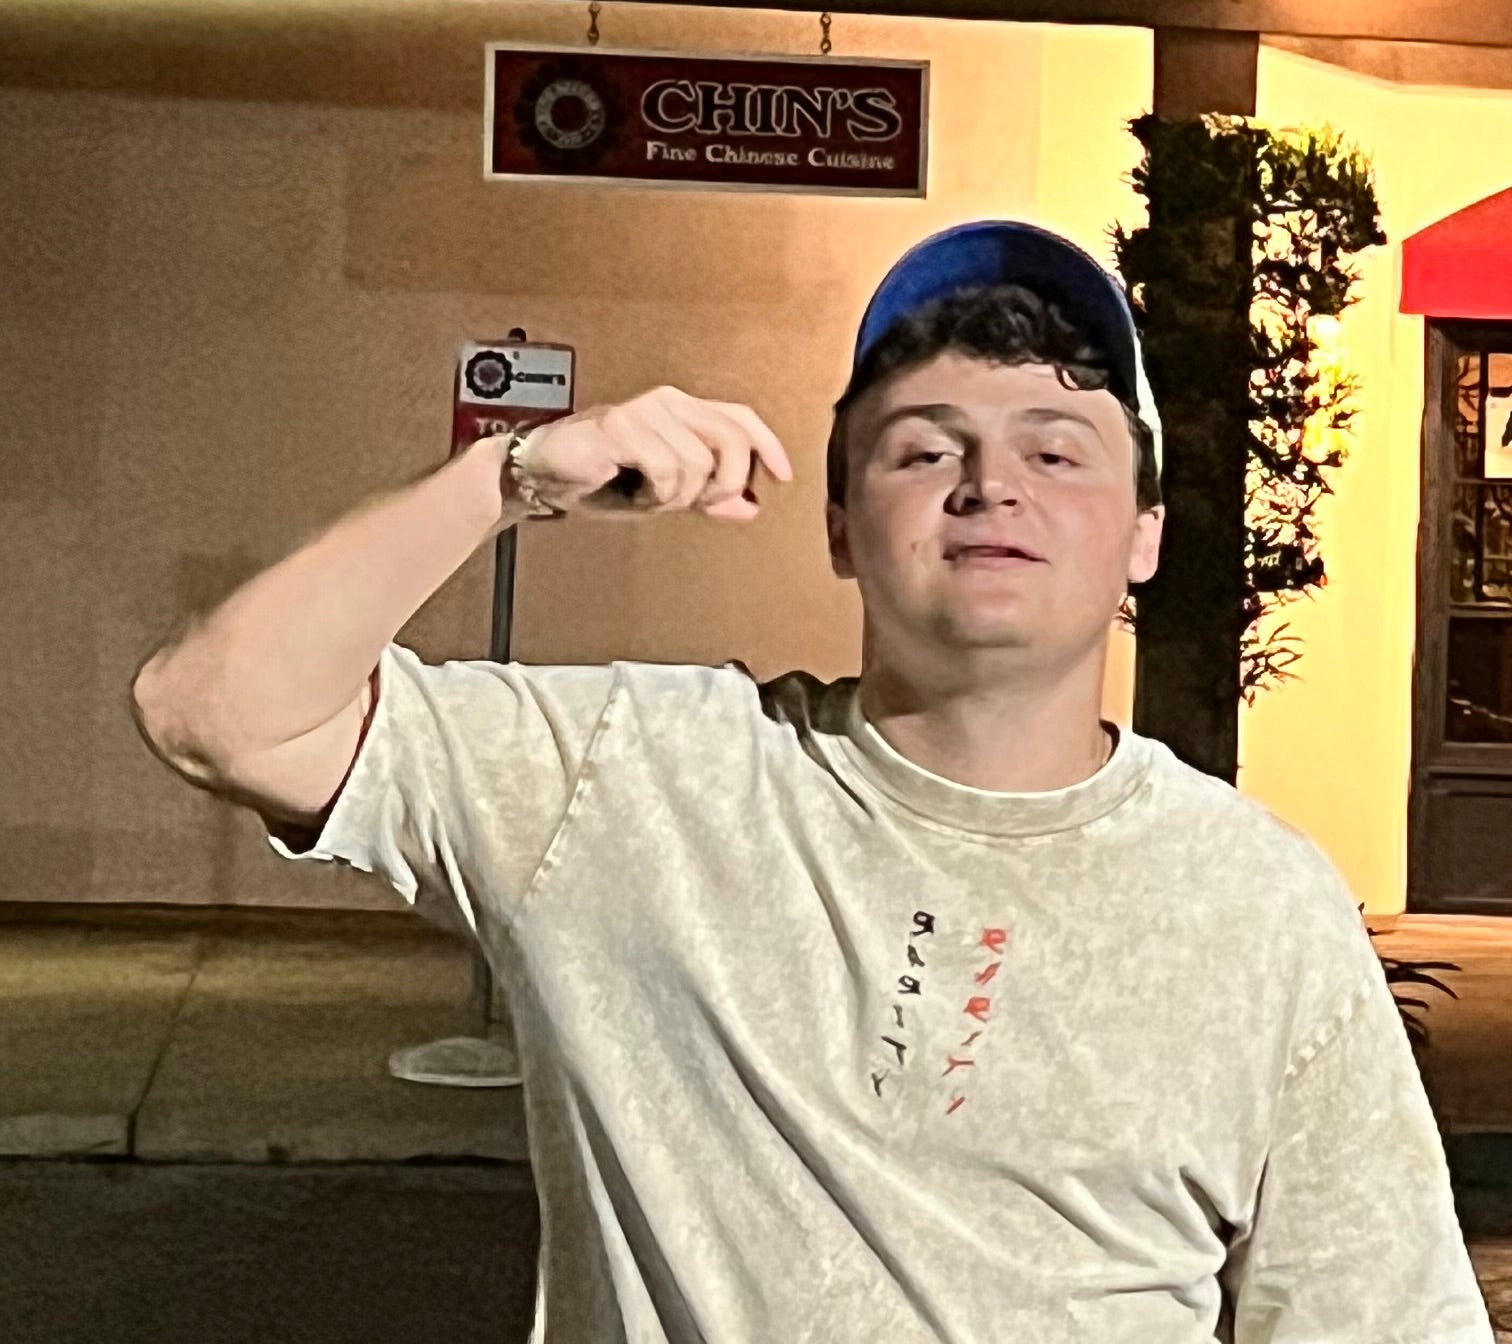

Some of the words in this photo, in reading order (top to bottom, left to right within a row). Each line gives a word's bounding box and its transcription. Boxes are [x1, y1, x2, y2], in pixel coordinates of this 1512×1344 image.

[641, 78, 902, 143] CHIN'S
[645, 140, 697, 162] Fine
[705, 143, 799, 166] Chinese
[807, 146, 896, 170] Cuisine
